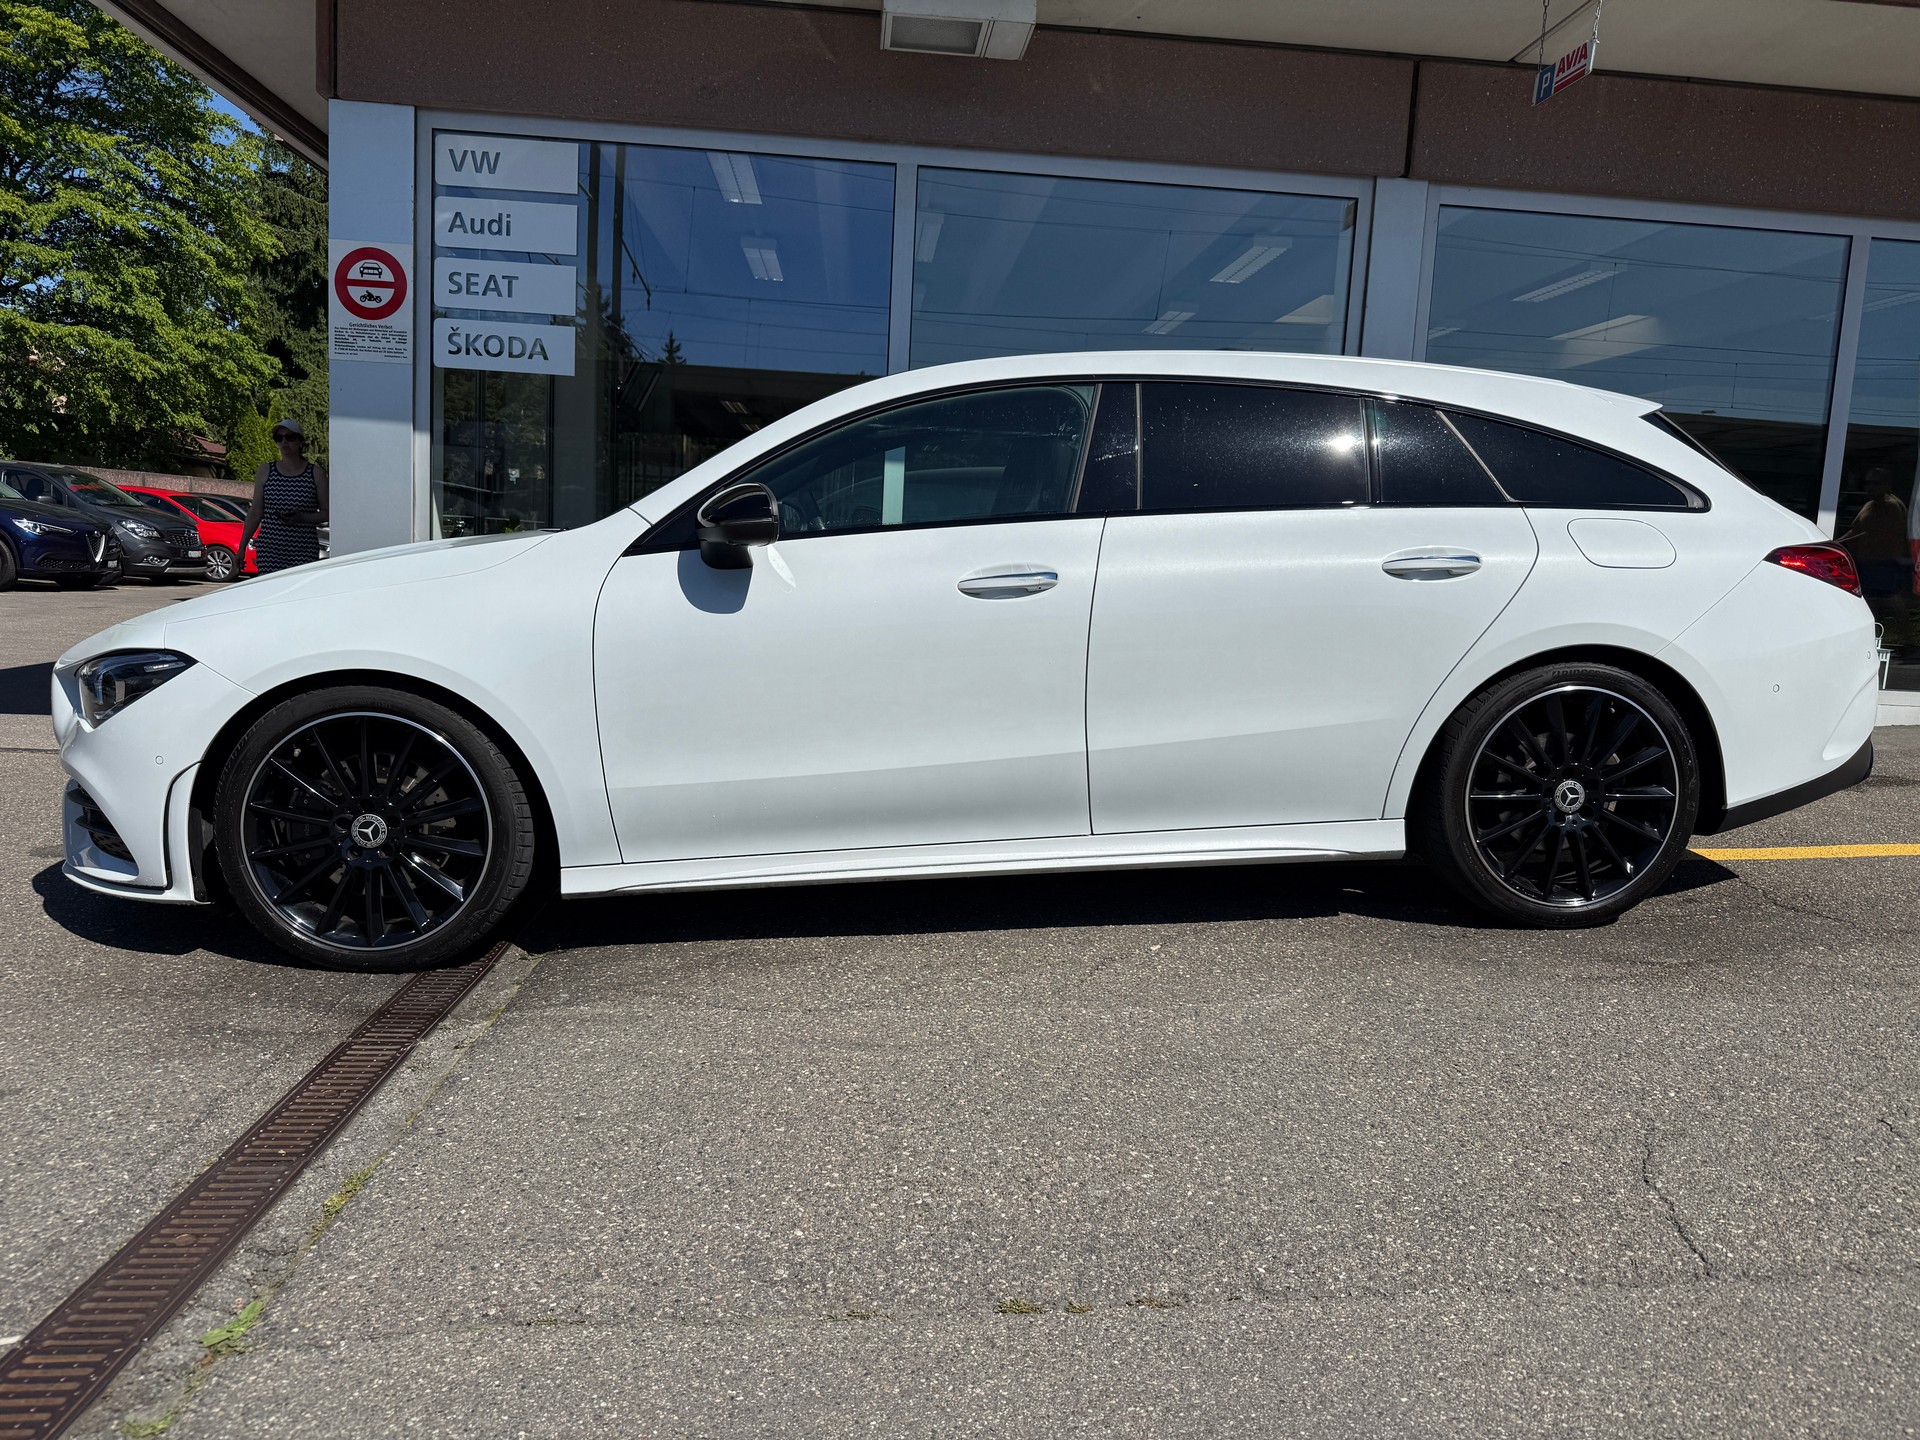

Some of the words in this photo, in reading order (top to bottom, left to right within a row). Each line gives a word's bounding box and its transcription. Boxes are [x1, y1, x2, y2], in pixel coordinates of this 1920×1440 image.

[1555, 42, 1588, 78] AVIA
[448, 148, 501, 175] VW
[447, 211, 512, 237] Audi
[448, 271, 519, 298] SEAT
[447, 326, 549, 361] ŠKODA
